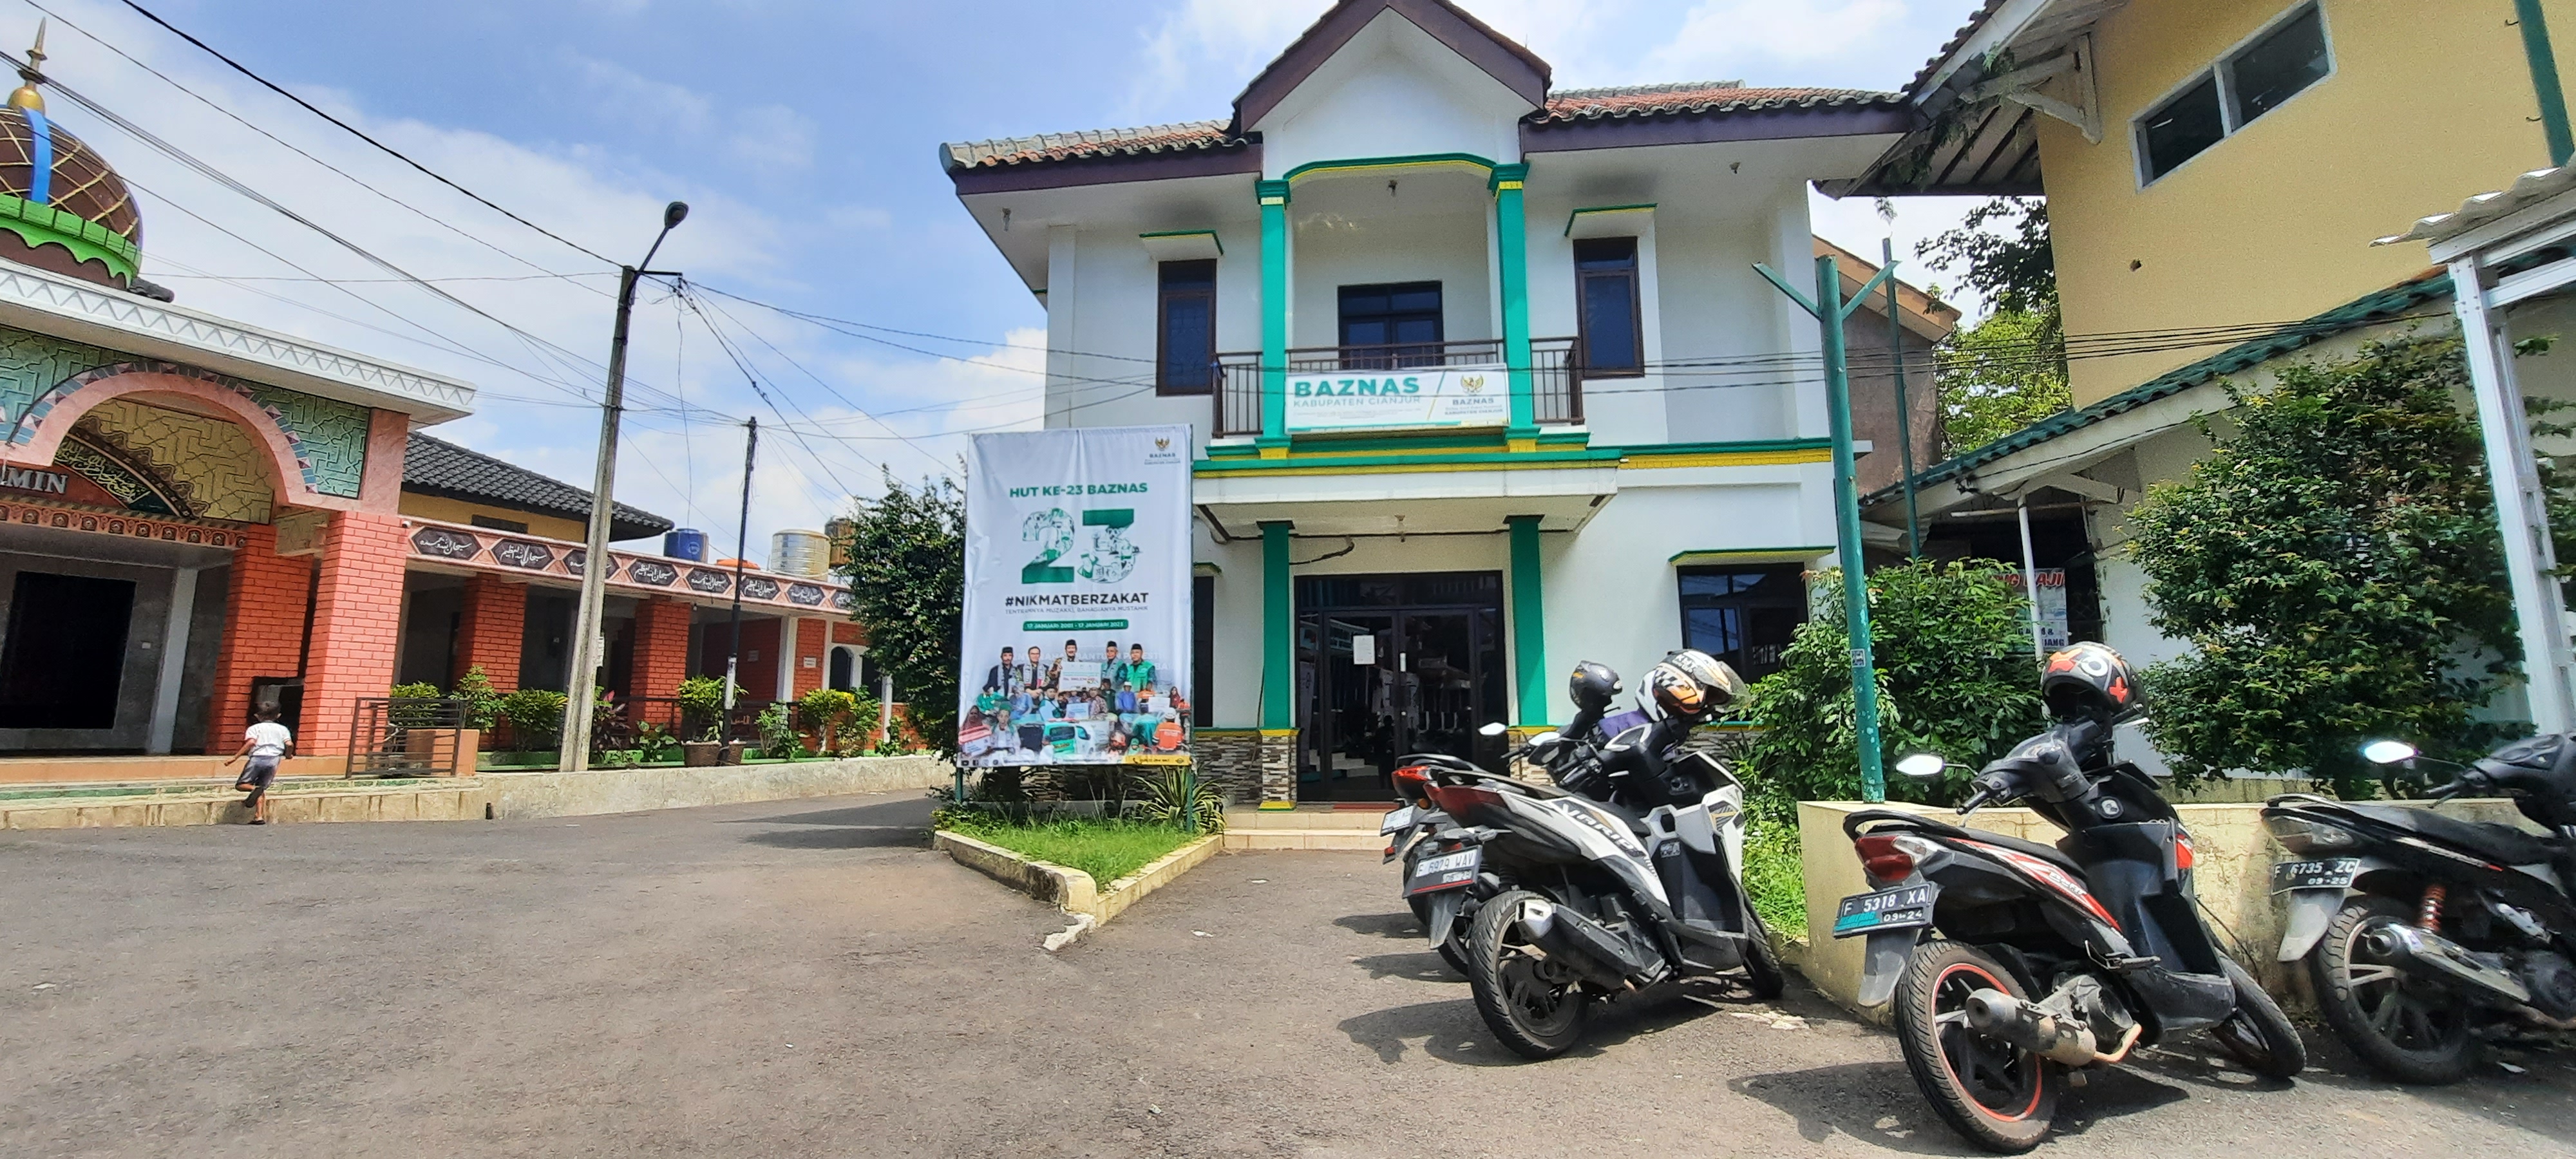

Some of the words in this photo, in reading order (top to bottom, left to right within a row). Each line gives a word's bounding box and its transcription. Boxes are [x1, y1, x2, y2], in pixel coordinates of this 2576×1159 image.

[1294, 377, 1419, 397] BAZNAS
[1294, 397, 1364, 408] KABUPATEN
[1368, 395, 1421, 406] CIANJUR
[1010, 487, 1039, 498] HUT
[1042, 484, 1083, 496] KE-23
[1087, 482, 1148, 495] BAZNAS
[1021, 507, 1137, 583] 23
[1005, 592, 1149, 607] #NIKMATBERZAKAT
[1418, 864, 1424, 875] F
[1428, 858, 1450, 873] 6979
[1455, 852, 1473, 867] WAV
[2275, 865, 2282, 879] F
[2290, 862, 2324, 874] 6735
[2334, 860, 2356, 873] ZC
[1843, 902, 1853, 916] F
[1863, 893, 1897, 913] 5318
[1906, 887, 1926, 905] XA
